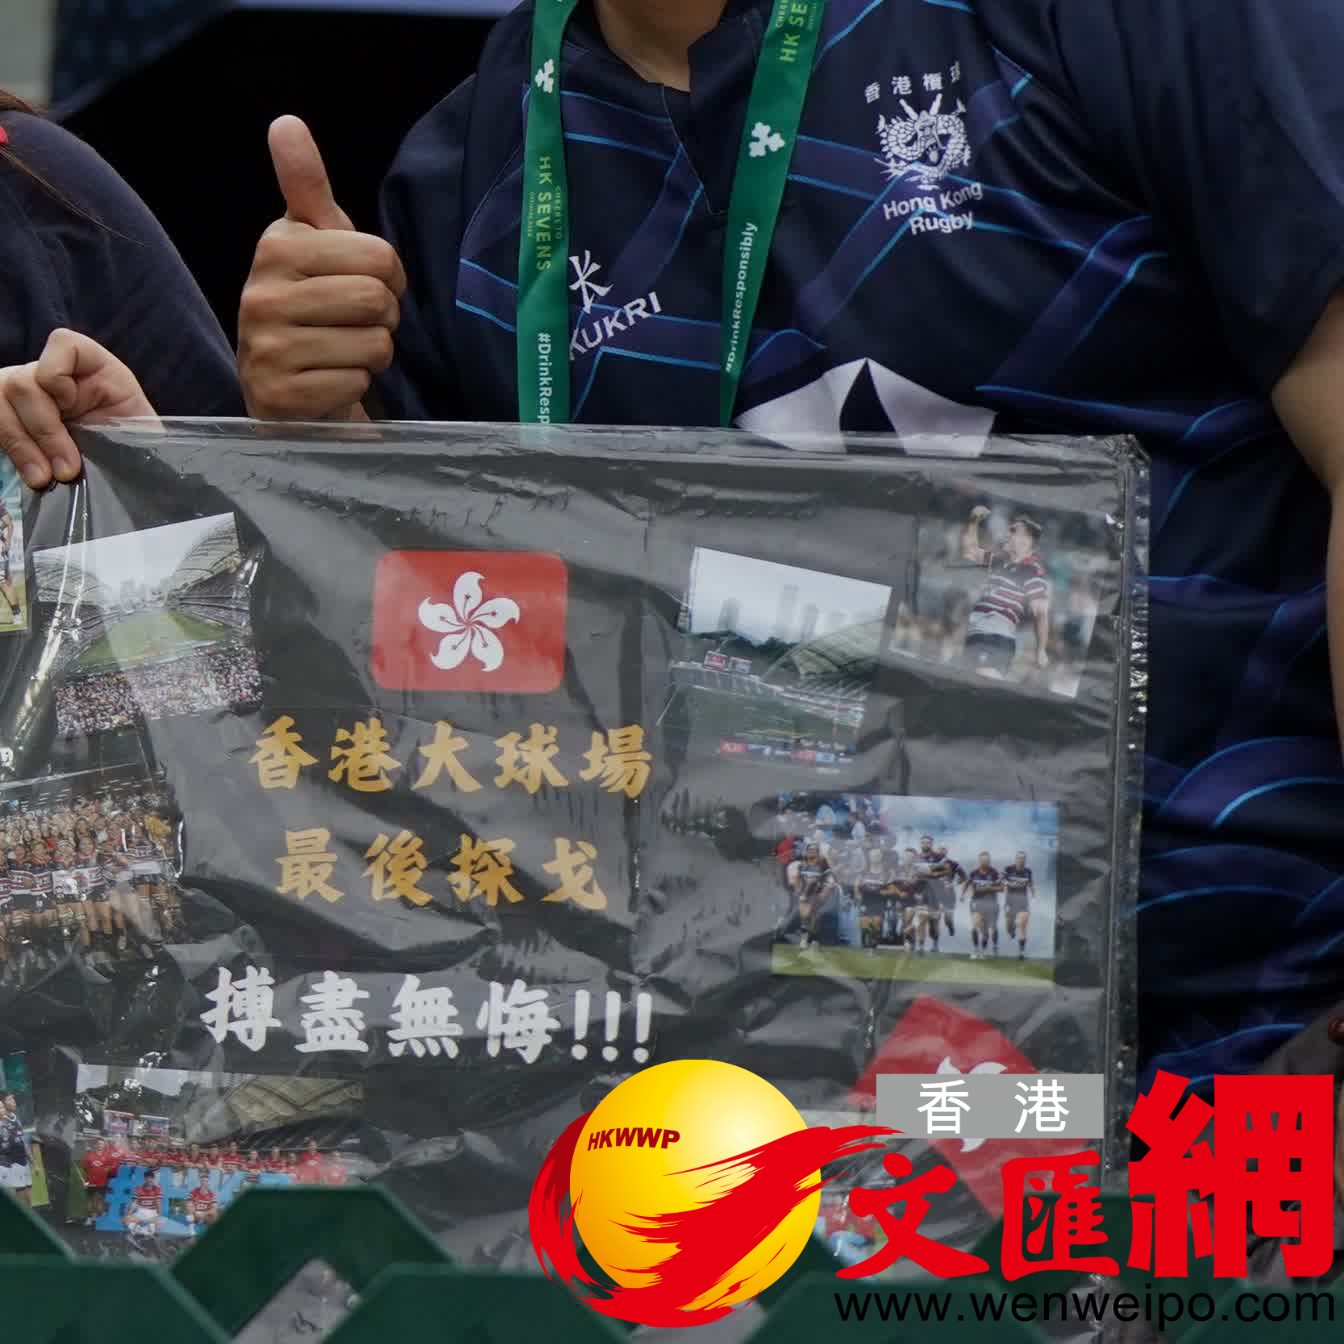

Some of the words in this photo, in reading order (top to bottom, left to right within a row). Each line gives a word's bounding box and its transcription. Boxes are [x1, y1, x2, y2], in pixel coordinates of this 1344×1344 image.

[779, 32, 801, 63] HK
[538, 155, 552, 185] HK
[883, 195, 937, 220] Hong
[940, 182, 984, 211] Kong
[536, 192, 552, 272] SEVENS
[909, 211, 974, 236] Rugby
[725, 221, 759, 373] #DrinkResponsibly
[248, 714, 654, 801] 香港大球場
[275, 827, 609, 911] 最後探戈
[199, 966, 654, 1064] 搏盡無悔!!!
